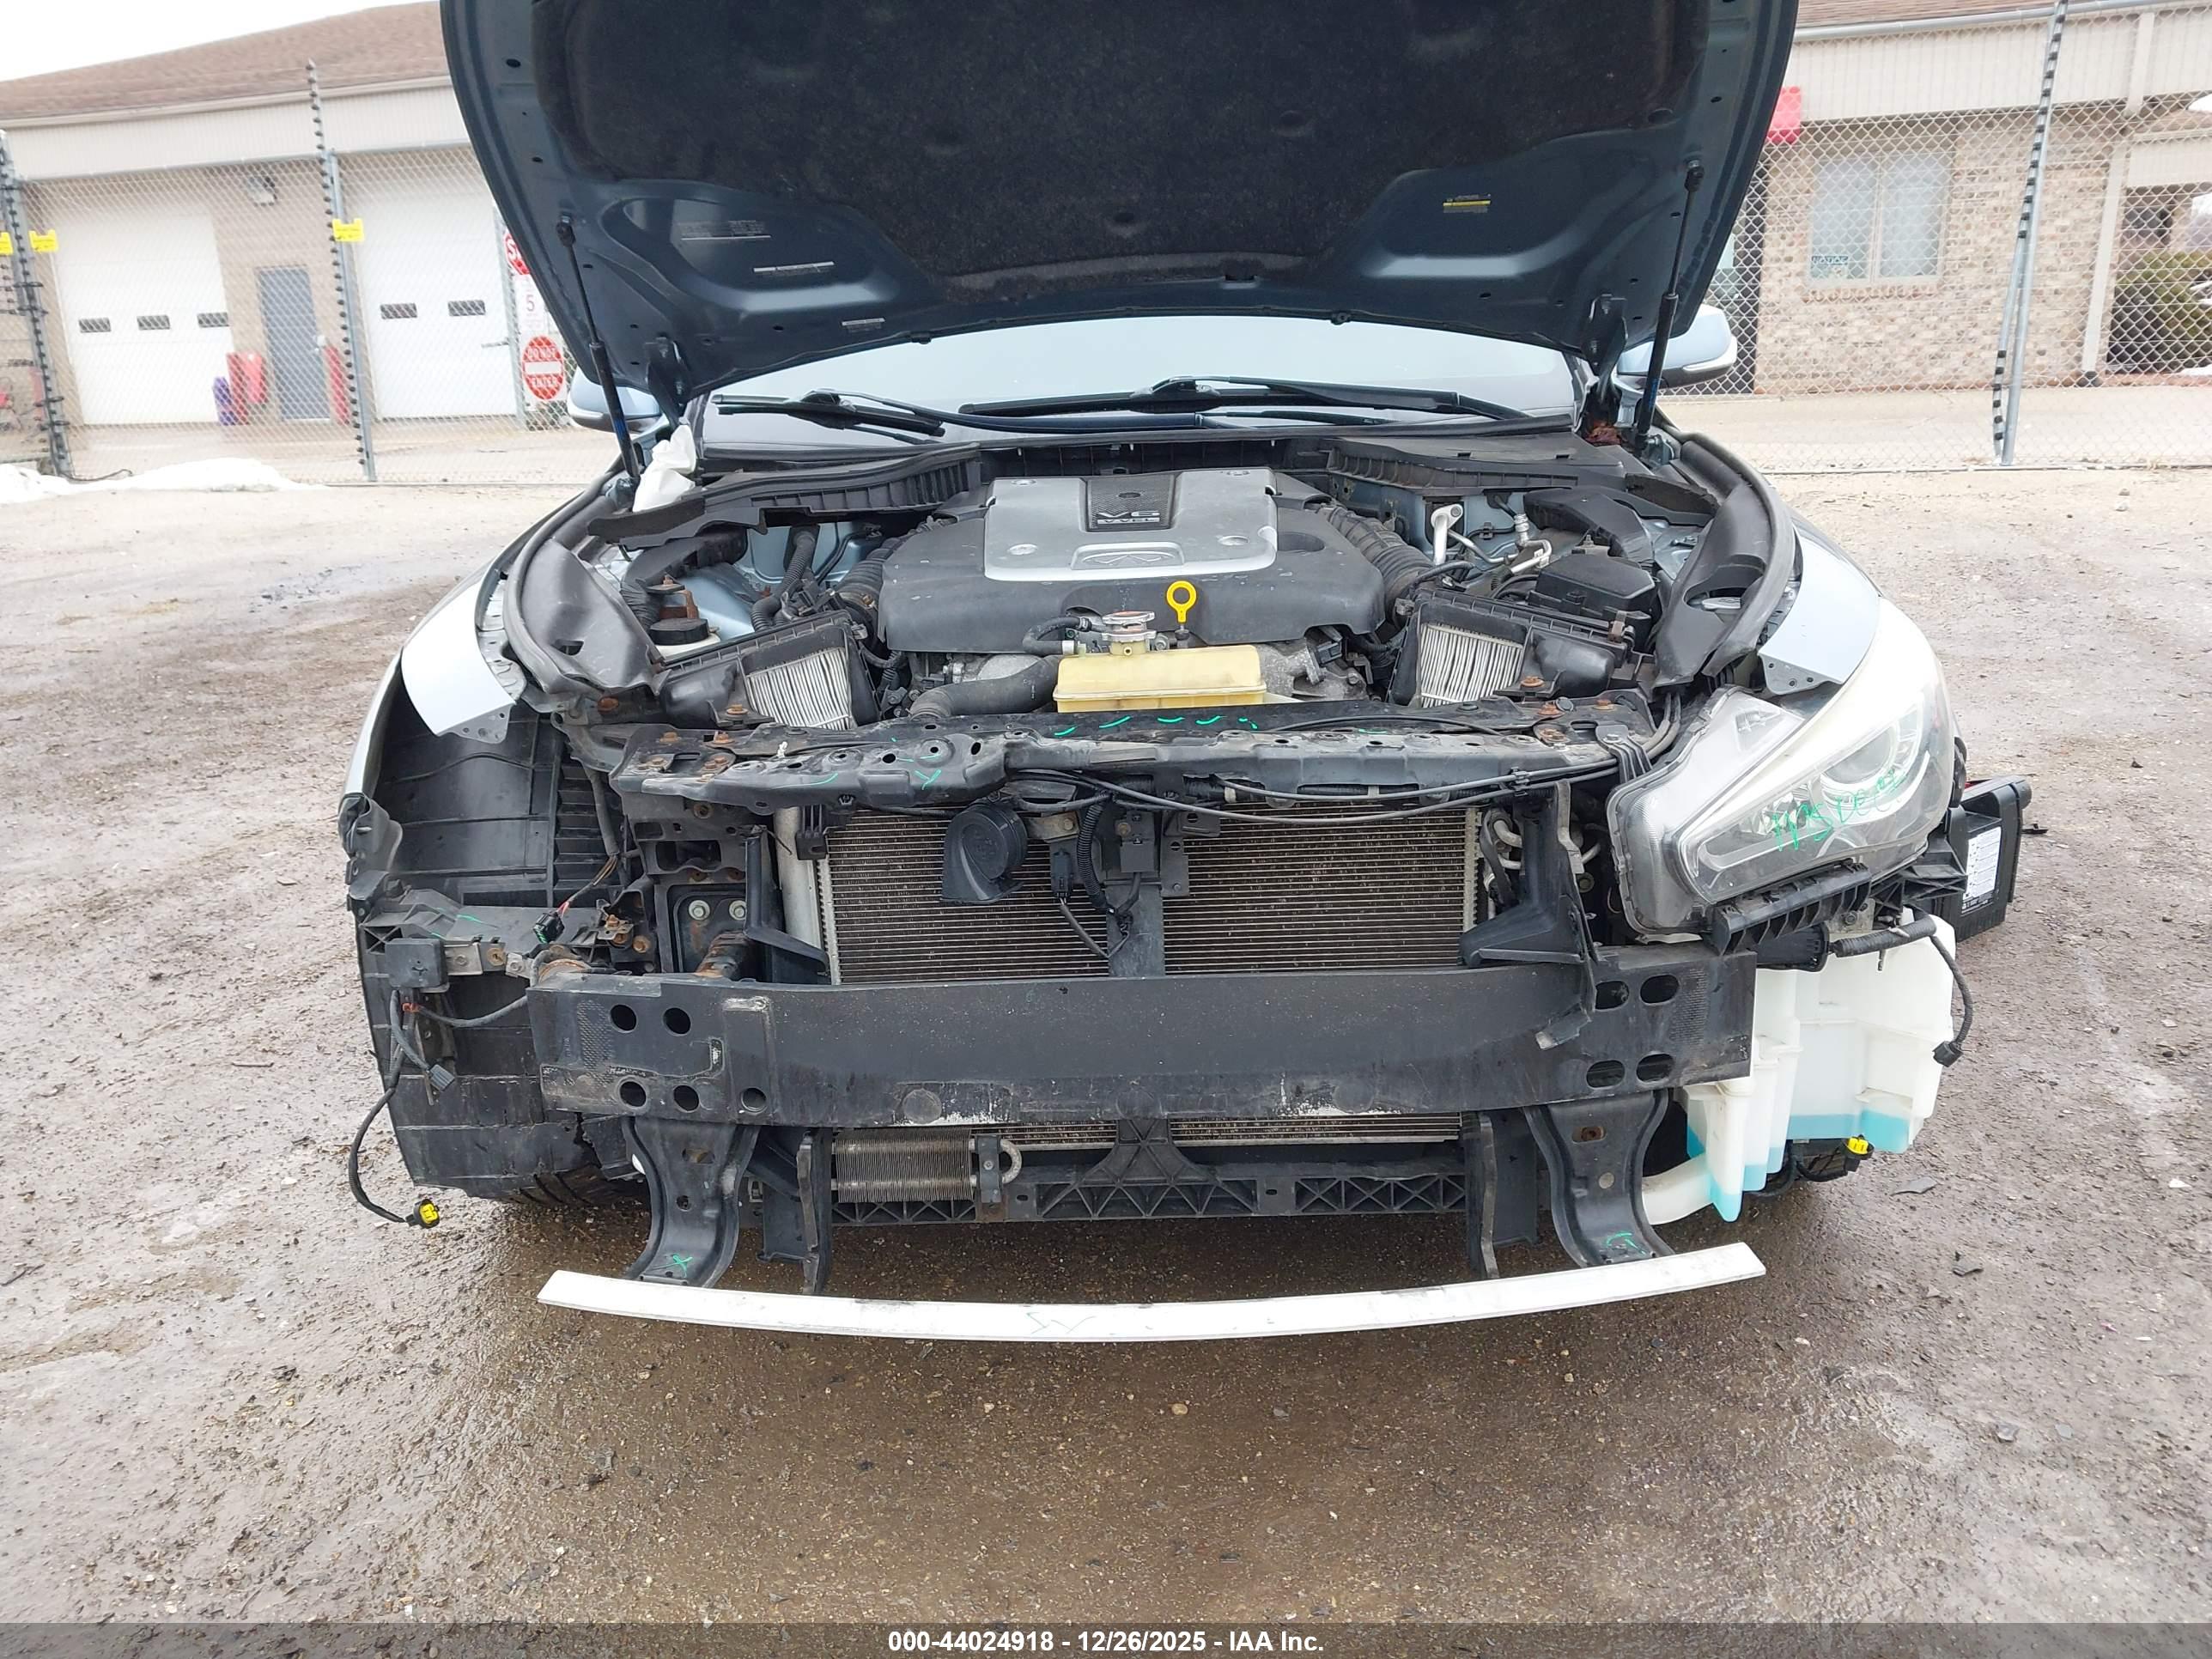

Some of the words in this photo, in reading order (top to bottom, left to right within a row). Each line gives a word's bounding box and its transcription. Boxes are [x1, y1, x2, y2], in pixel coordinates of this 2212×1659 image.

[526, 295, 535, 312] 5
[527, 347, 539, 357] DO
[540, 346, 556, 357] NOT
[531, 377, 557, 386] ENTER
